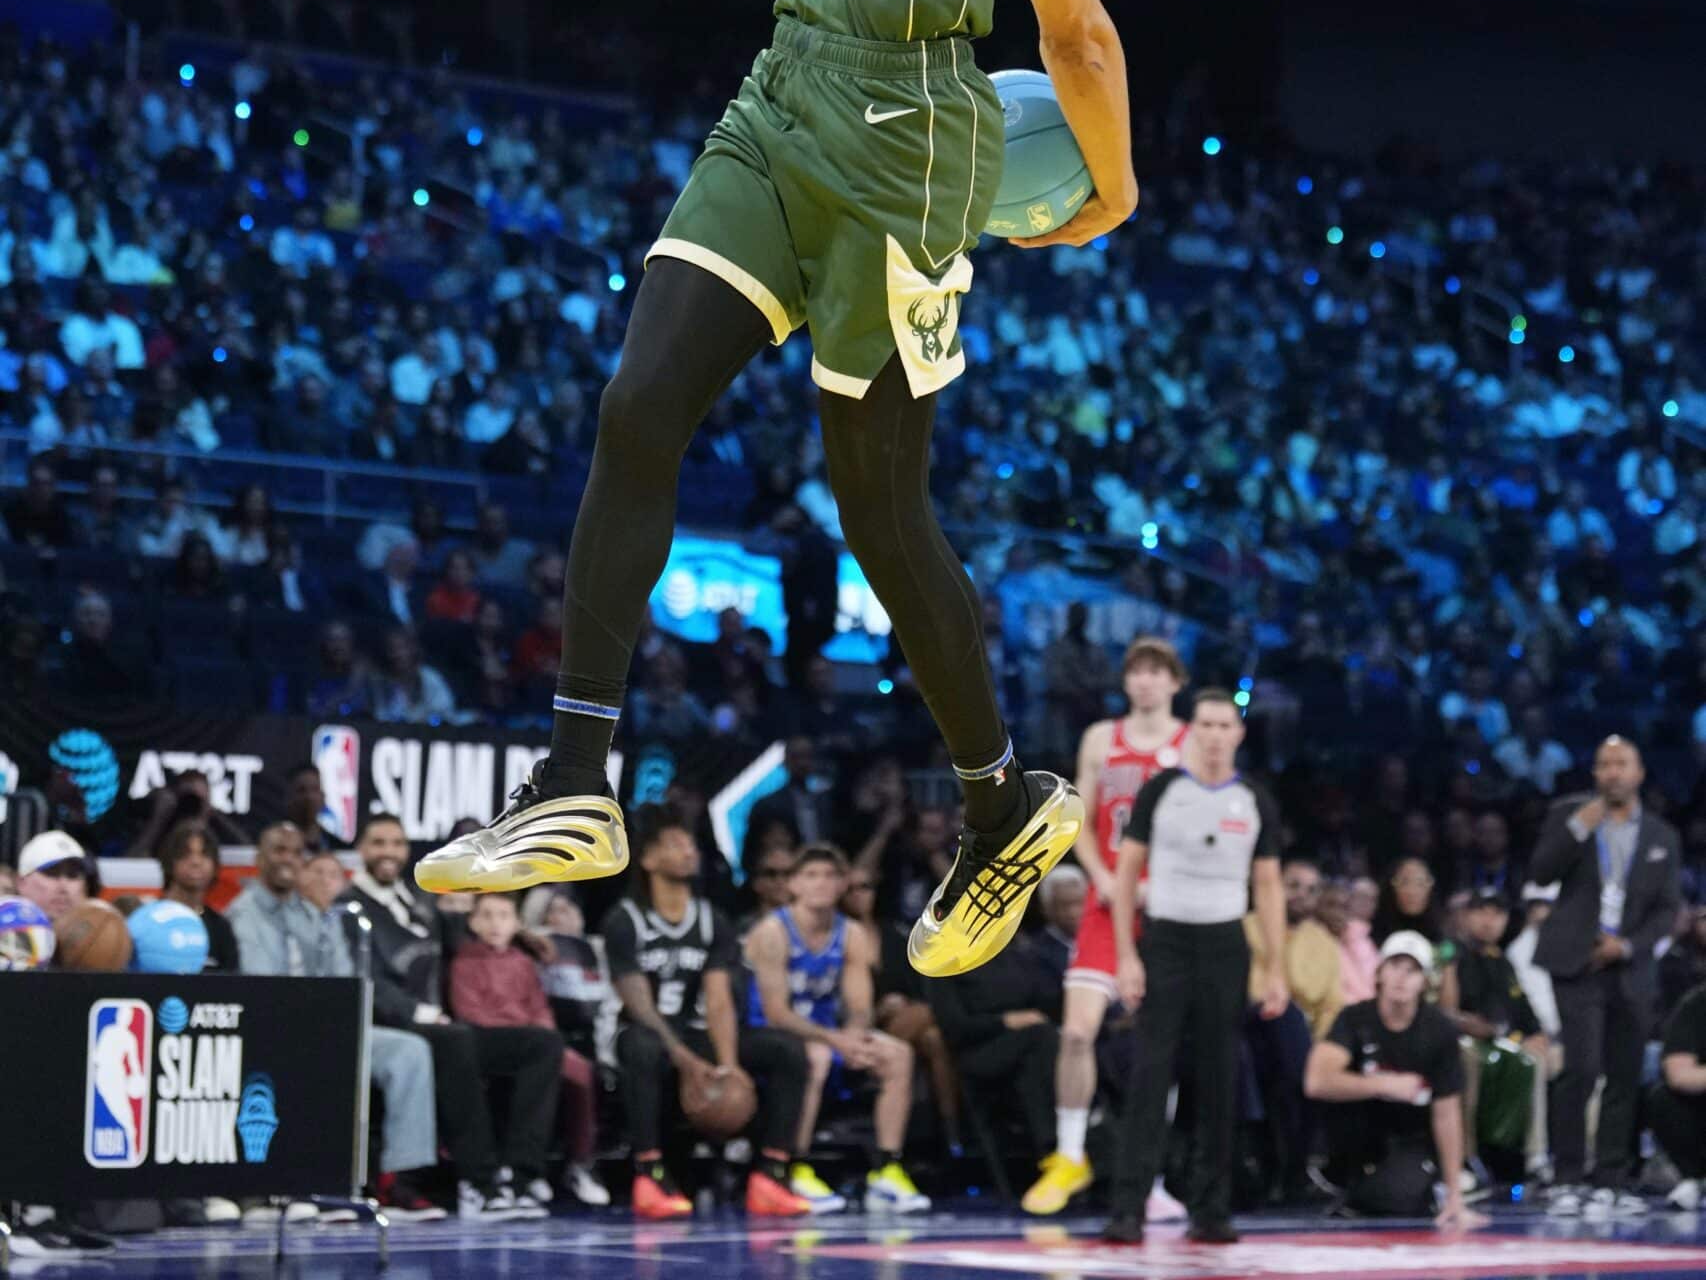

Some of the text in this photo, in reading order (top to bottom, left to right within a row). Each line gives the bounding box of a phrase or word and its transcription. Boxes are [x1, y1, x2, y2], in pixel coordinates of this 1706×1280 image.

[370, 737, 495, 841] SLAM
[189, 1003, 243, 1029] AT&T
[156, 1034, 243, 1100] SLAM
[154, 1099, 239, 1165] DUNK
